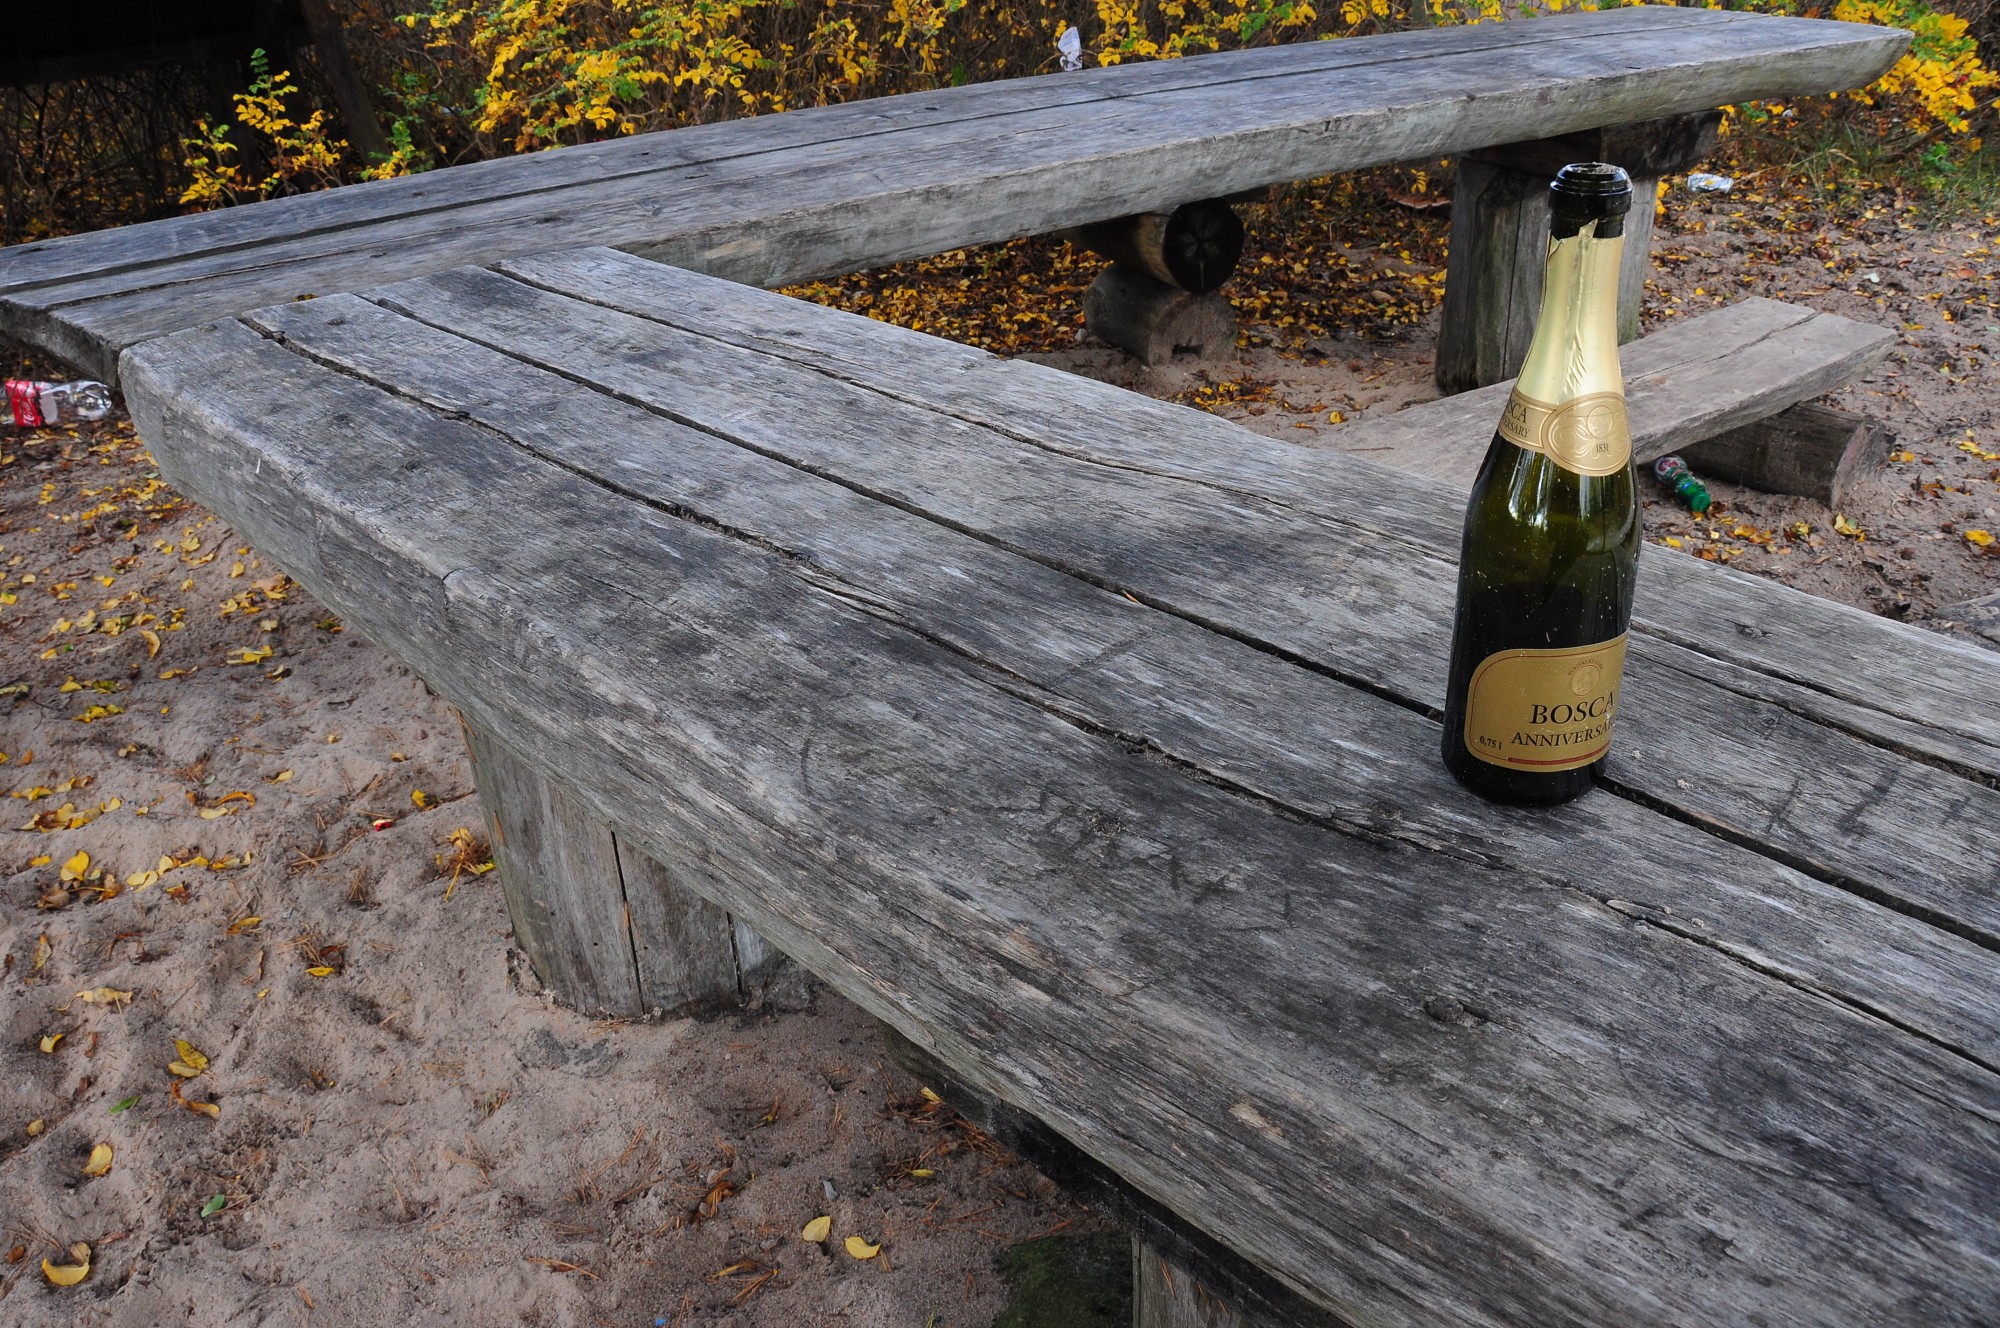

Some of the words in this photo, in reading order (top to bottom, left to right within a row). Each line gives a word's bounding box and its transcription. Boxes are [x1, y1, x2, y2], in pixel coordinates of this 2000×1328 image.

[1595, 442, 1609, 452] 1831
[1528, 691, 1615, 725] BOSCA
[1479, 735, 1498, 749] 0,75
[1510, 717, 1615, 748] ANNIVERSAR
